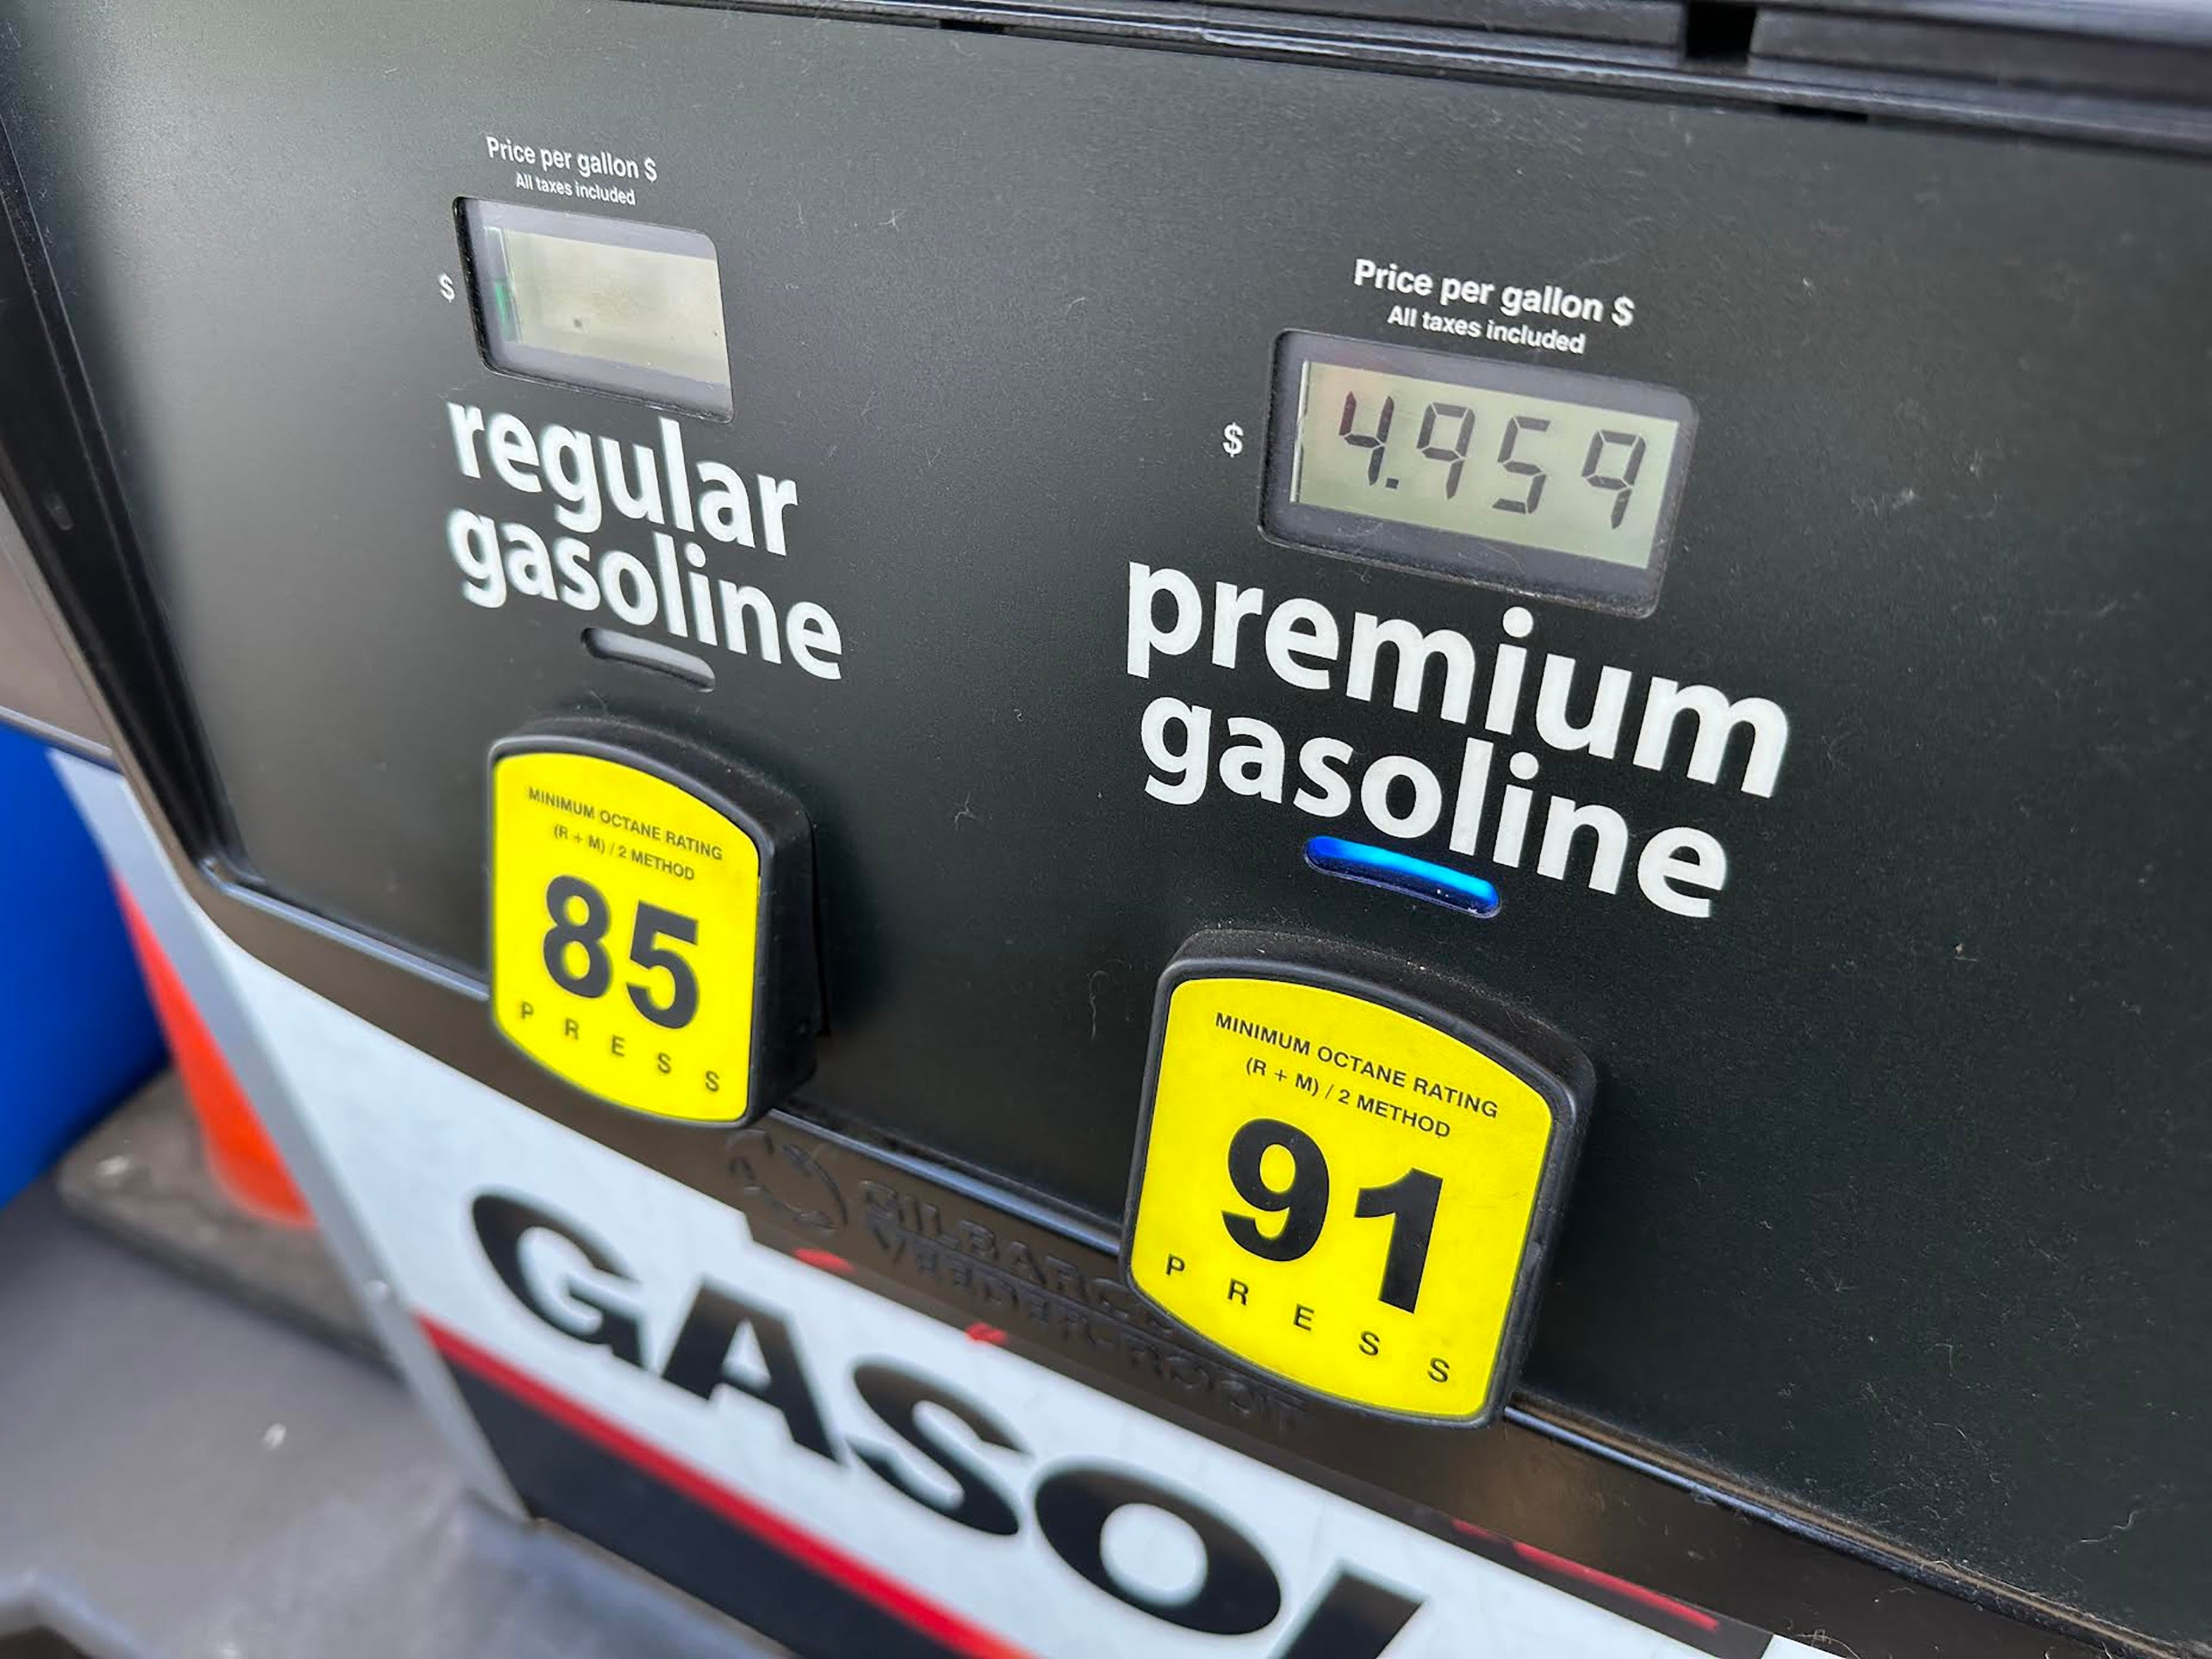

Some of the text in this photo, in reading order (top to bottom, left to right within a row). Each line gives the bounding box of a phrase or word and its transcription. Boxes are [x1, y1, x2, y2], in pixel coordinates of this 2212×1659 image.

[485, 136, 658, 184] Price per gallon $
[516, 173, 636, 206] All taxes included
[439, 274, 456, 302] $
[1354, 258, 1635, 327] Price per gallon $
[1387, 305, 1586, 355] All taxes included
[1222, 422, 1244, 457] $
[1339, 392, 1646, 529] 4.959
[447, 402, 798, 556] regular
[448, 508, 841, 680] gasoline
[1127, 562, 1790, 799] premium
[529, 786, 723, 860] MINIMUM OCTANE RATING
[1141, 695, 1727, 918] gasoline
[631, 849, 695, 880] METHOD
[543, 874, 700, 1029] 85
[1215, 1012, 1498, 1118] MINIMUM OCTANE RATING
[1357, 1094, 1451, 1138] METHOD
[1221, 1118, 1443, 1315] 91
